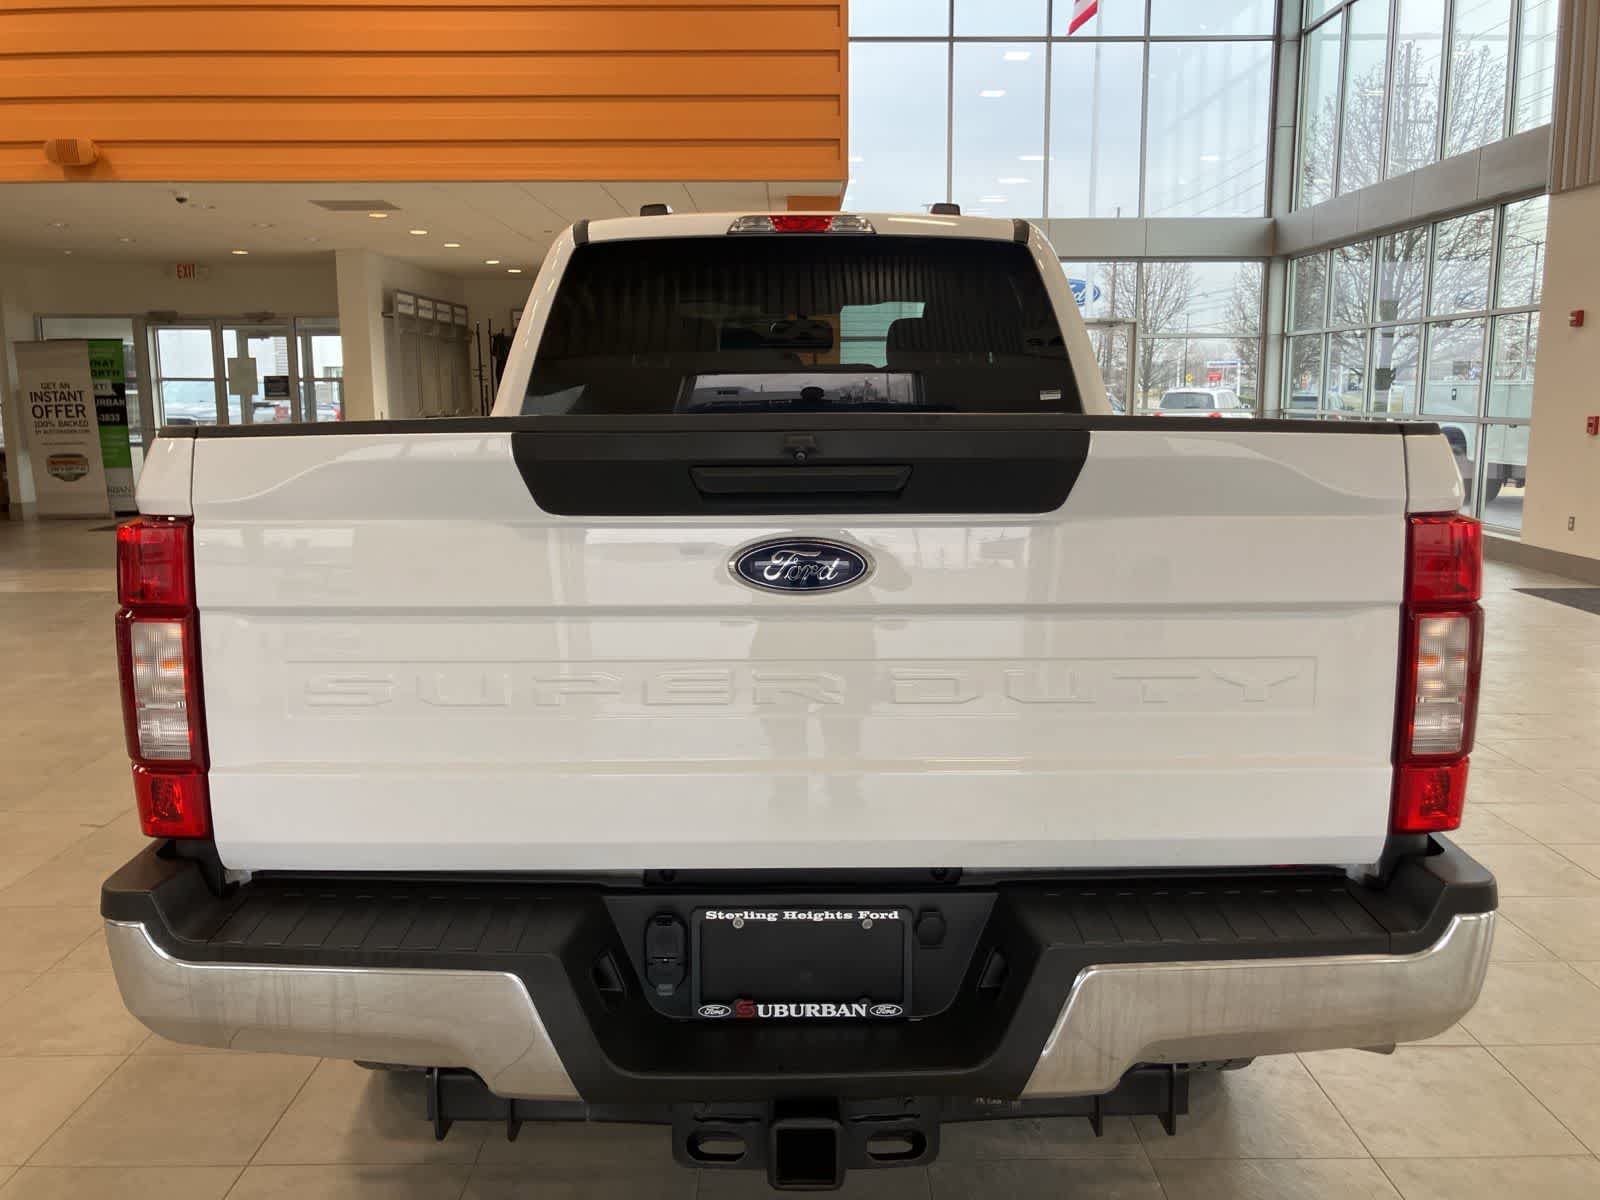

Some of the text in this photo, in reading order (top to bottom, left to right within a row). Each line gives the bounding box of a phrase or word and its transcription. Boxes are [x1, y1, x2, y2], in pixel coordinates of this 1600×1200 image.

[176, 263, 195, 280] EXIT
[29, 390, 84, 403] INSTANT
[31, 404, 87, 419] OFFER
[763, 549, 841, 582] Ford
[302, 666, 1300, 708] SUPER DUTY
[705, 910, 899, 922] Sterling Heights Ford
[702, 1005, 727, 1016] Ford
[736, 1001, 868, 1018] SUBURBAN
[874, 1004, 898, 1015] Ford
